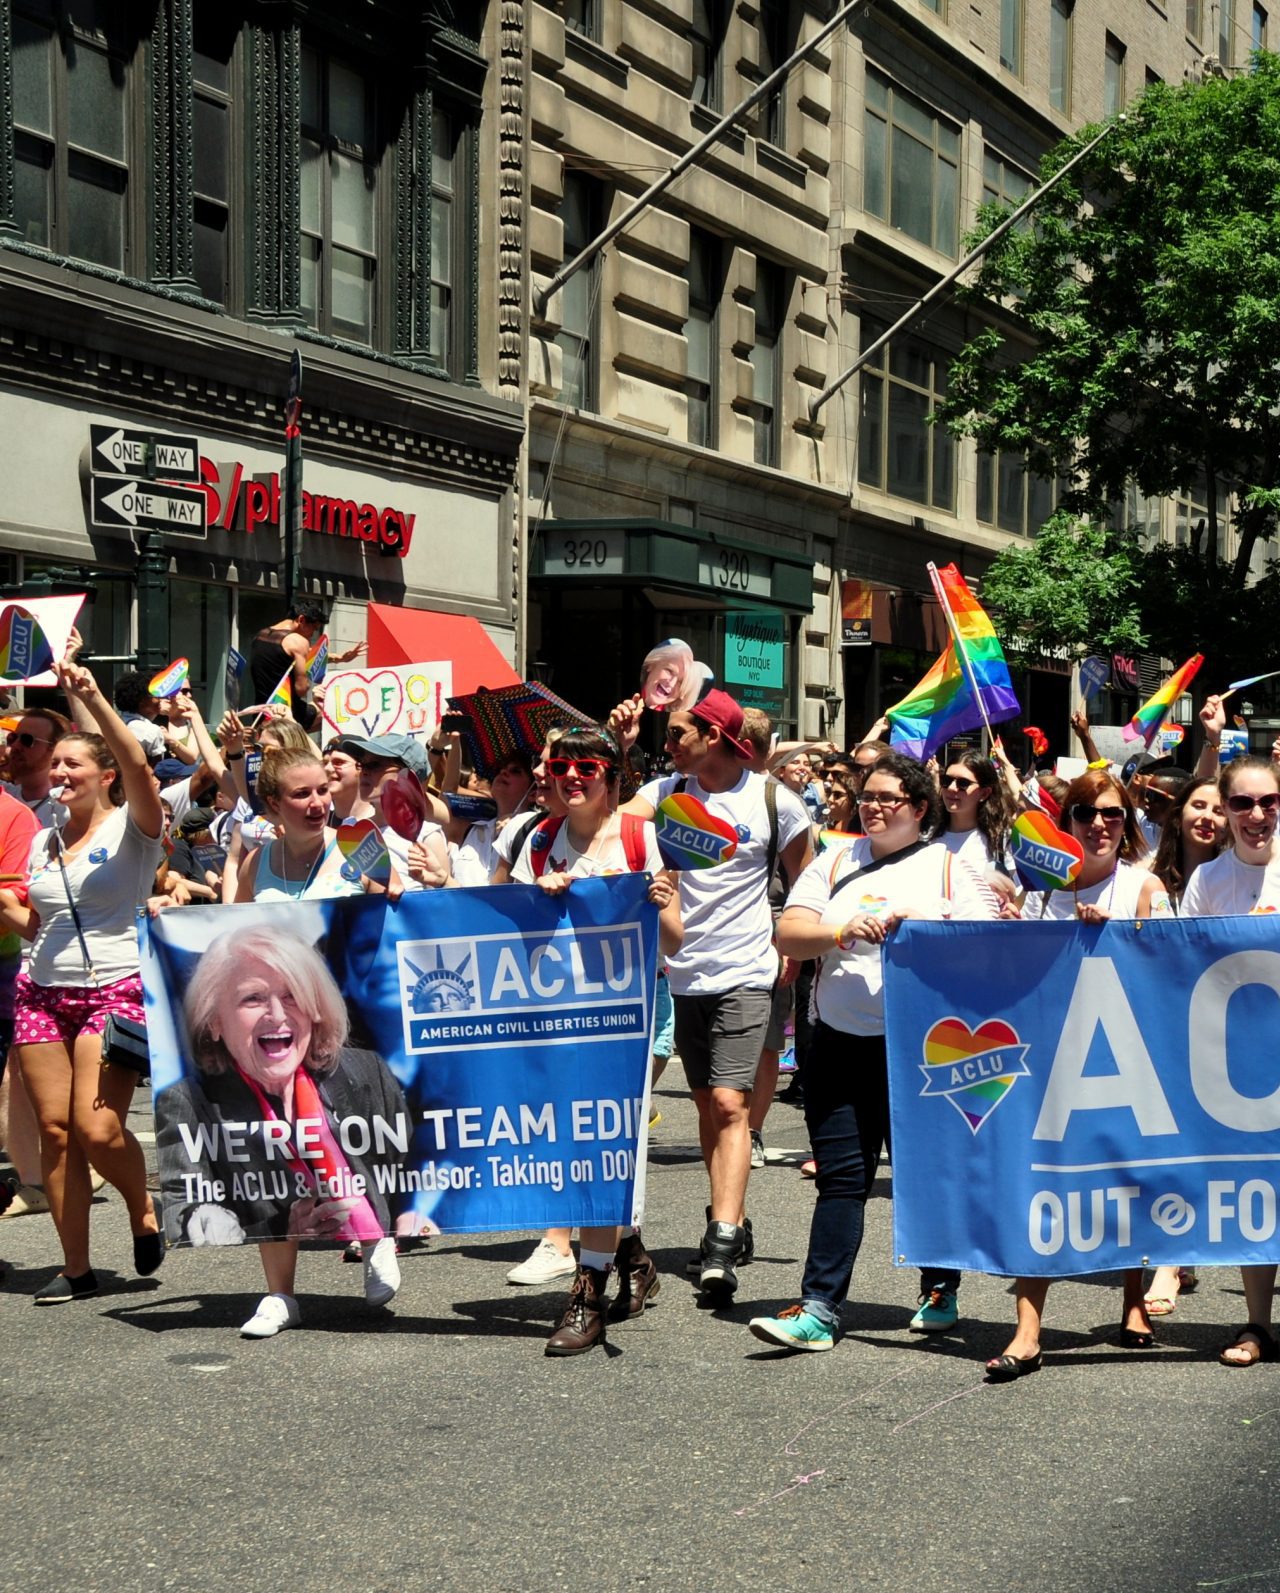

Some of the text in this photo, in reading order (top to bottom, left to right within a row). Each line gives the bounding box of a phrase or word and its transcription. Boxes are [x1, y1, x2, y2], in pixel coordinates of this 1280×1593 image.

[112, 441, 187, 468] ONE WAY
[121, 494, 196, 522] ONE WAY
[564, 540, 607, 567] 320
[719, 550, 750, 590] 320
[14, 624, 29, 666] ACLU
[729, 615, 778, 656] Mystique
[312, 645, 326, 673] ACLU
[738, 654, 771, 671] BOUTIQUE
[748, 672, 761, 681] NYC
[1162, 732, 1177, 741] CLU
[359, 839, 378, 865] ACLU
[670, 827, 716, 853] ACLU
[1025, 845, 1065, 872] ACLU
[490, 937, 634, 1000] ACLU
[420, 1012, 636, 1040] AMERICAN CIVIL LIBERTIES UNION
[950, 1054, 1004, 1085] ACLU
[178, 1117, 325, 1164] WE'RE
[339, 1113, 408, 1157] ON
[423, 1103, 556, 1151] TEAM
[180, 1171, 226, 1205] The
[232, 1169, 287, 1201] ACLU
[295, 1172, 312, 1198] &
[315, 1166, 367, 1199] Edie
[373, 1161, 483, 1196] Windsor:
[490, 1155, 565, 1194] Taking
[570, 1158, 594, 1184] on
[1028, 1185, 1141, 1257] OUT
